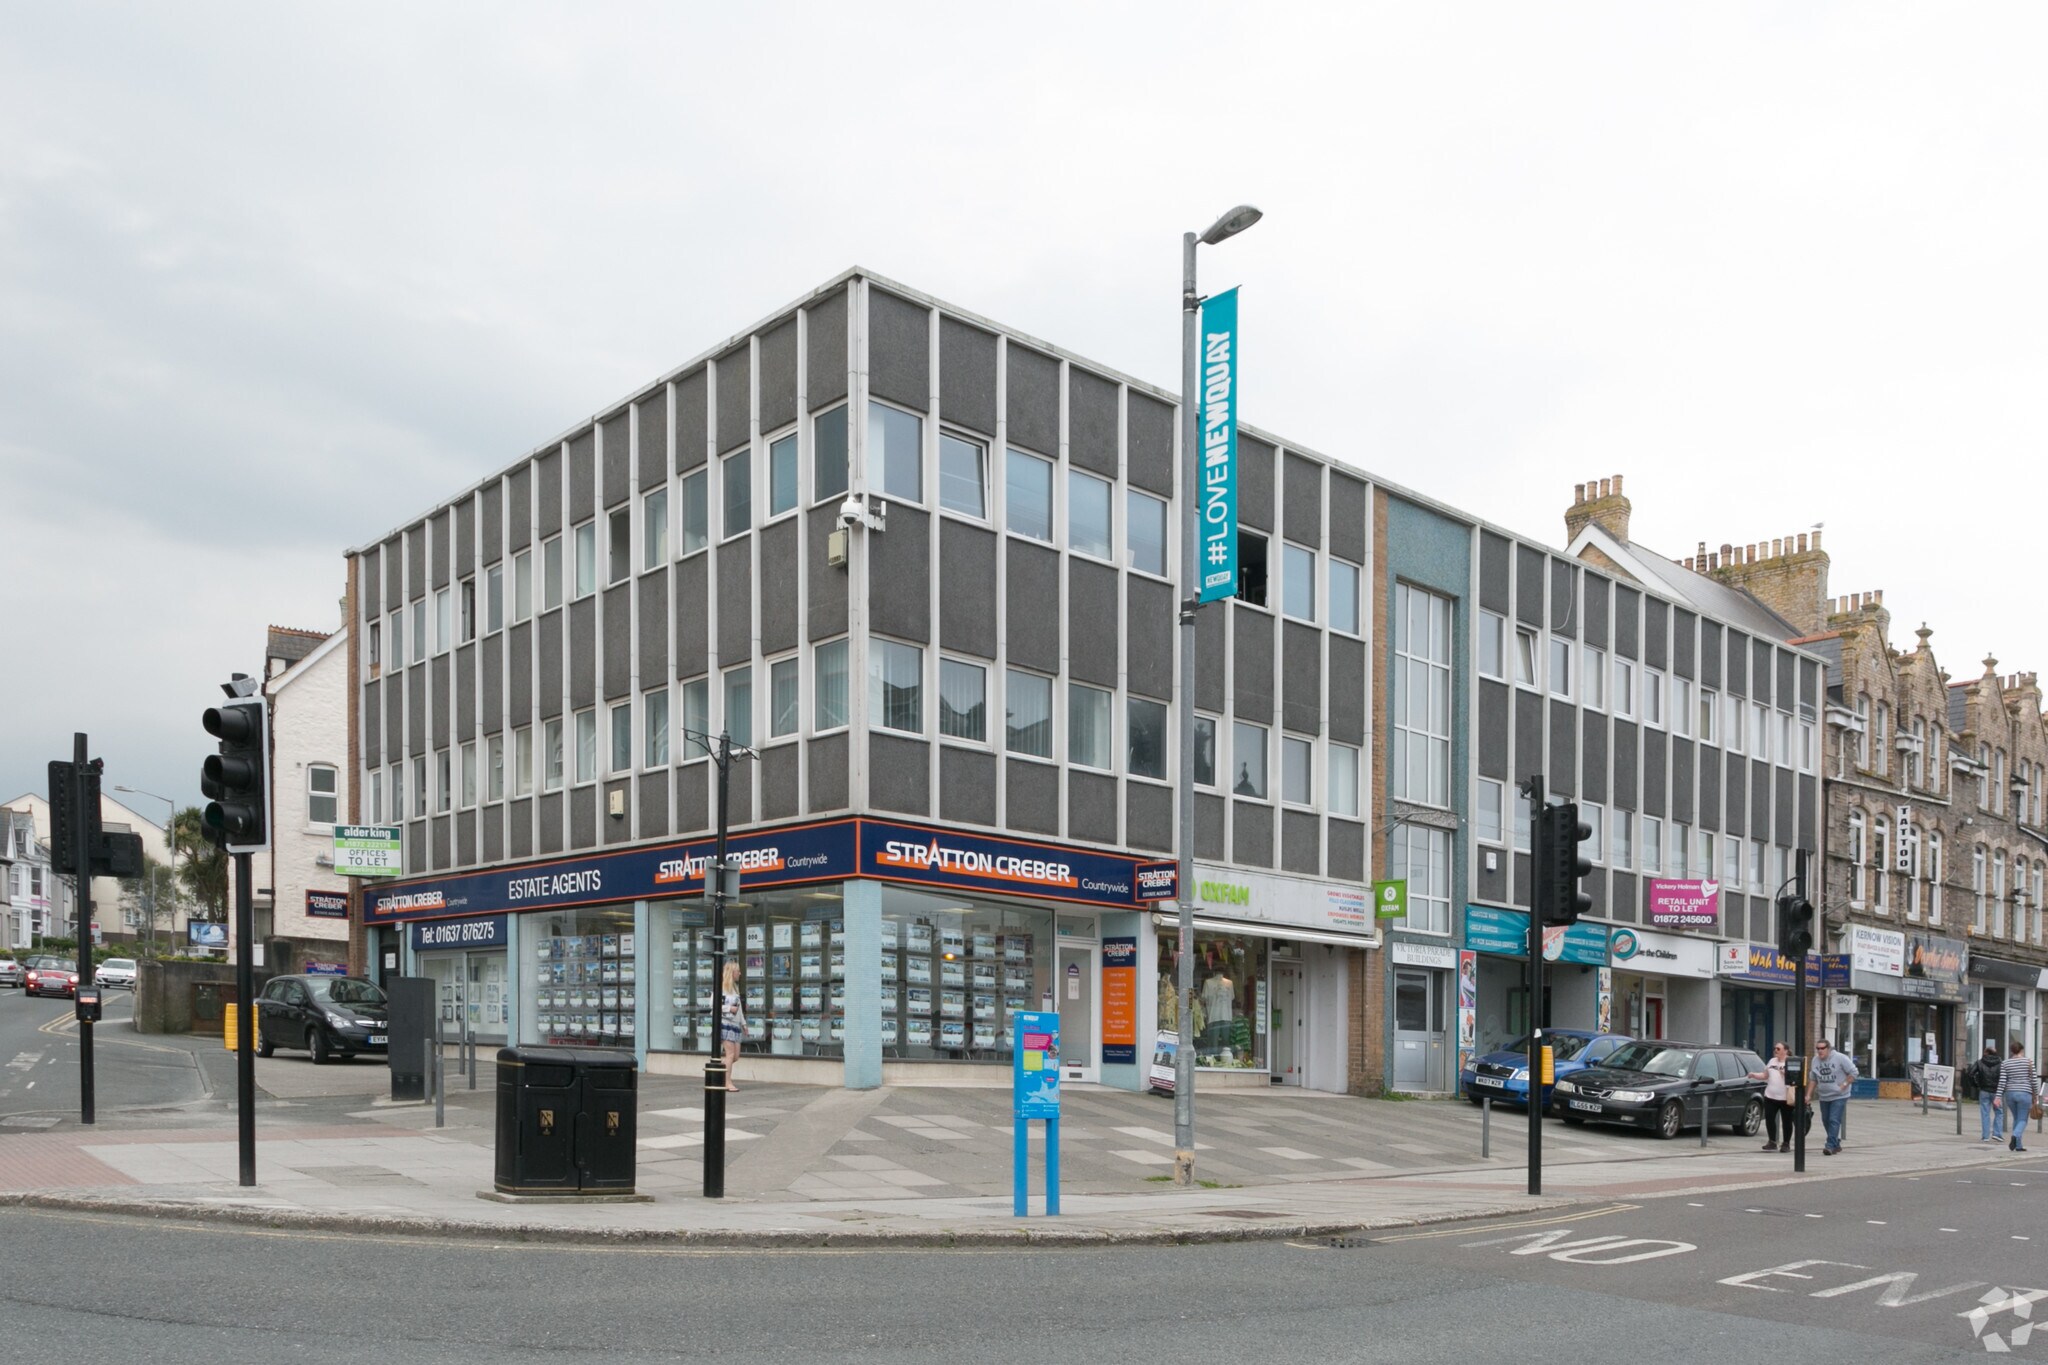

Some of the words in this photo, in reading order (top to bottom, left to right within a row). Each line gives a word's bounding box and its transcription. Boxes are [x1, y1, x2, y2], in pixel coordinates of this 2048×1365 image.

[1205, 331, 1232, 566] #LOVENEWQUAY
[1900, 807, 1909, 867] TATTOO
[349, 849, 387, 857] OFFICES
[348, 857, 363, 866] TO
[367, 857, 388, 866] LET
[787, 853, 828, 869] Countrywide
[886, 837, 993, 874] STRATTON
[995, 855, 1071, 883] CREBER
[1081, 877, 1129, 895] Countrywide
[1138, 869, 1175, 881] STRATTON
[509, 876, 550, 900] ESTATE
[551, 869, 601, 895] AGENTS
[1142, 879, 1171, 888] CREBER
[1655, 883, 1677, 891] Vickery
[1201, 880, 1250, 906] OXFAM
[310, 895, 347, 905] STRATTON
[314, 902, 343, 910] CREBER
[377, 893, 412, 912] STRATTON
[413, 891, 443, 907] CREBER
[1657, 897, 1687, 905] RETAIL
[1380, 904, 1400, 912] OXFAM
[1654, 915, 1679, 923] 01872
[1680, 915, 1712, 924] 245600
[421, 927, 434, 944] Tel:
[436, 924, 460, 942] 01637
[462, 921, 494, 941] 876275
[1856, 930, 1881, 942] KERNOW
[1882, 934, 1901, 946] VISION
[1104, 941, 1133, 951] STRATTON
[1395, 943, 1426, 955] VICTORIA
[1427, 946, 1451, 957] PARADE
[1107, 949, 1130, 957] CREBER
[1407, 953, 1441, 965] BUILDINGS
[1655, 949, 1677, 960] Children
[1749, 950, 1772, 969] Wah
[1776, 954, 1796, 972] Hin
[1837, 996, 1851, 1006] sky
[1929, 1072, 1948, 1084] sky
[1458, 1229, 1698, 1265] NO
